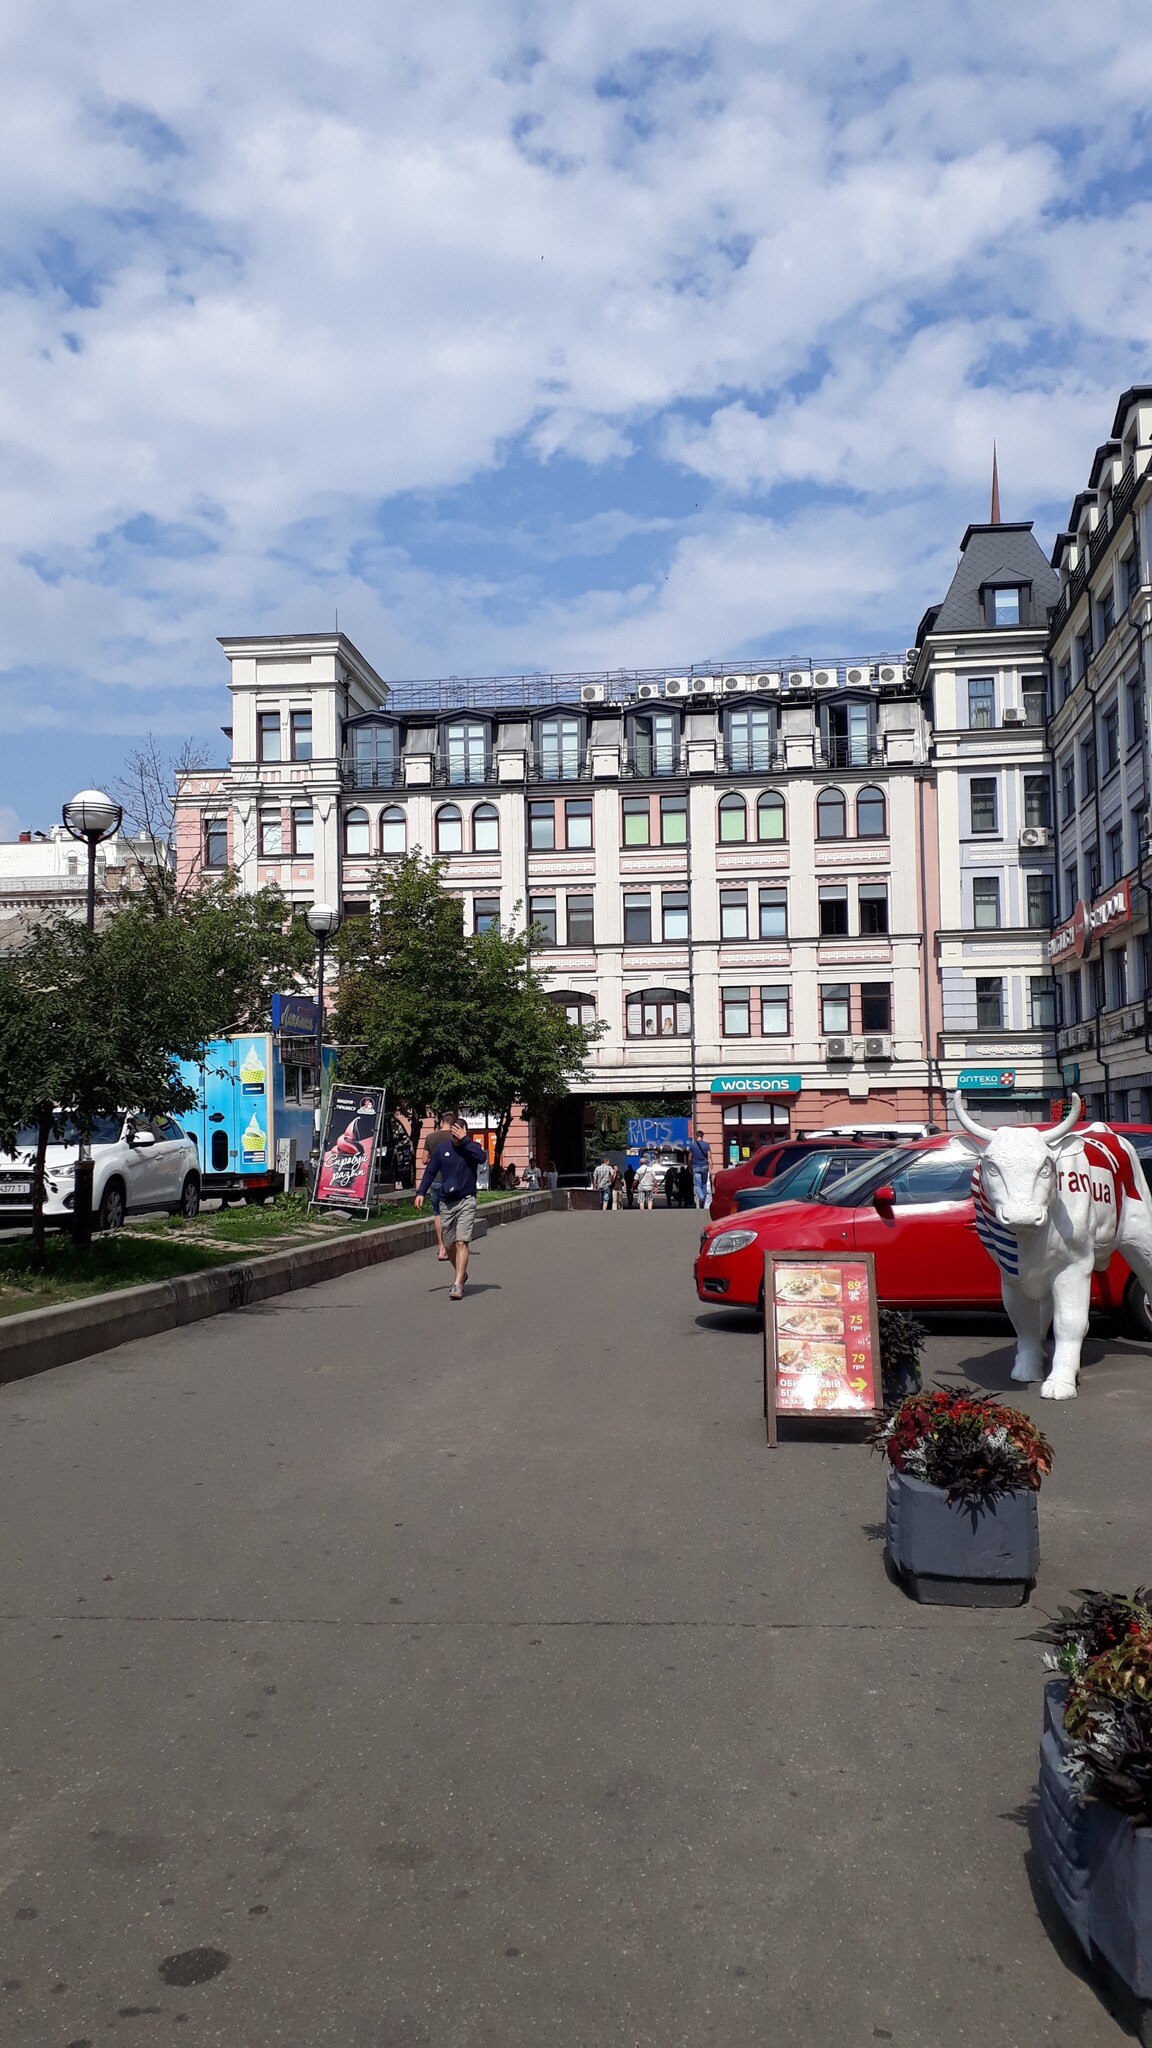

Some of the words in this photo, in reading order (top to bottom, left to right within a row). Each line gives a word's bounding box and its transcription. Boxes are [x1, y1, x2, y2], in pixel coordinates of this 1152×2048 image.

[1090, 892, 1127, 928] SCHOOL
[721, 1079, 790, 1091] watsons
[325, 1152, 368, 1172] Спробуй
[847, 1280, 861, 1290] 89
[849, 1315, 863, 1325] 75
[851, 1353, 865, 1363] 79
[819, 1378, 841, 1388] СВІЙ
